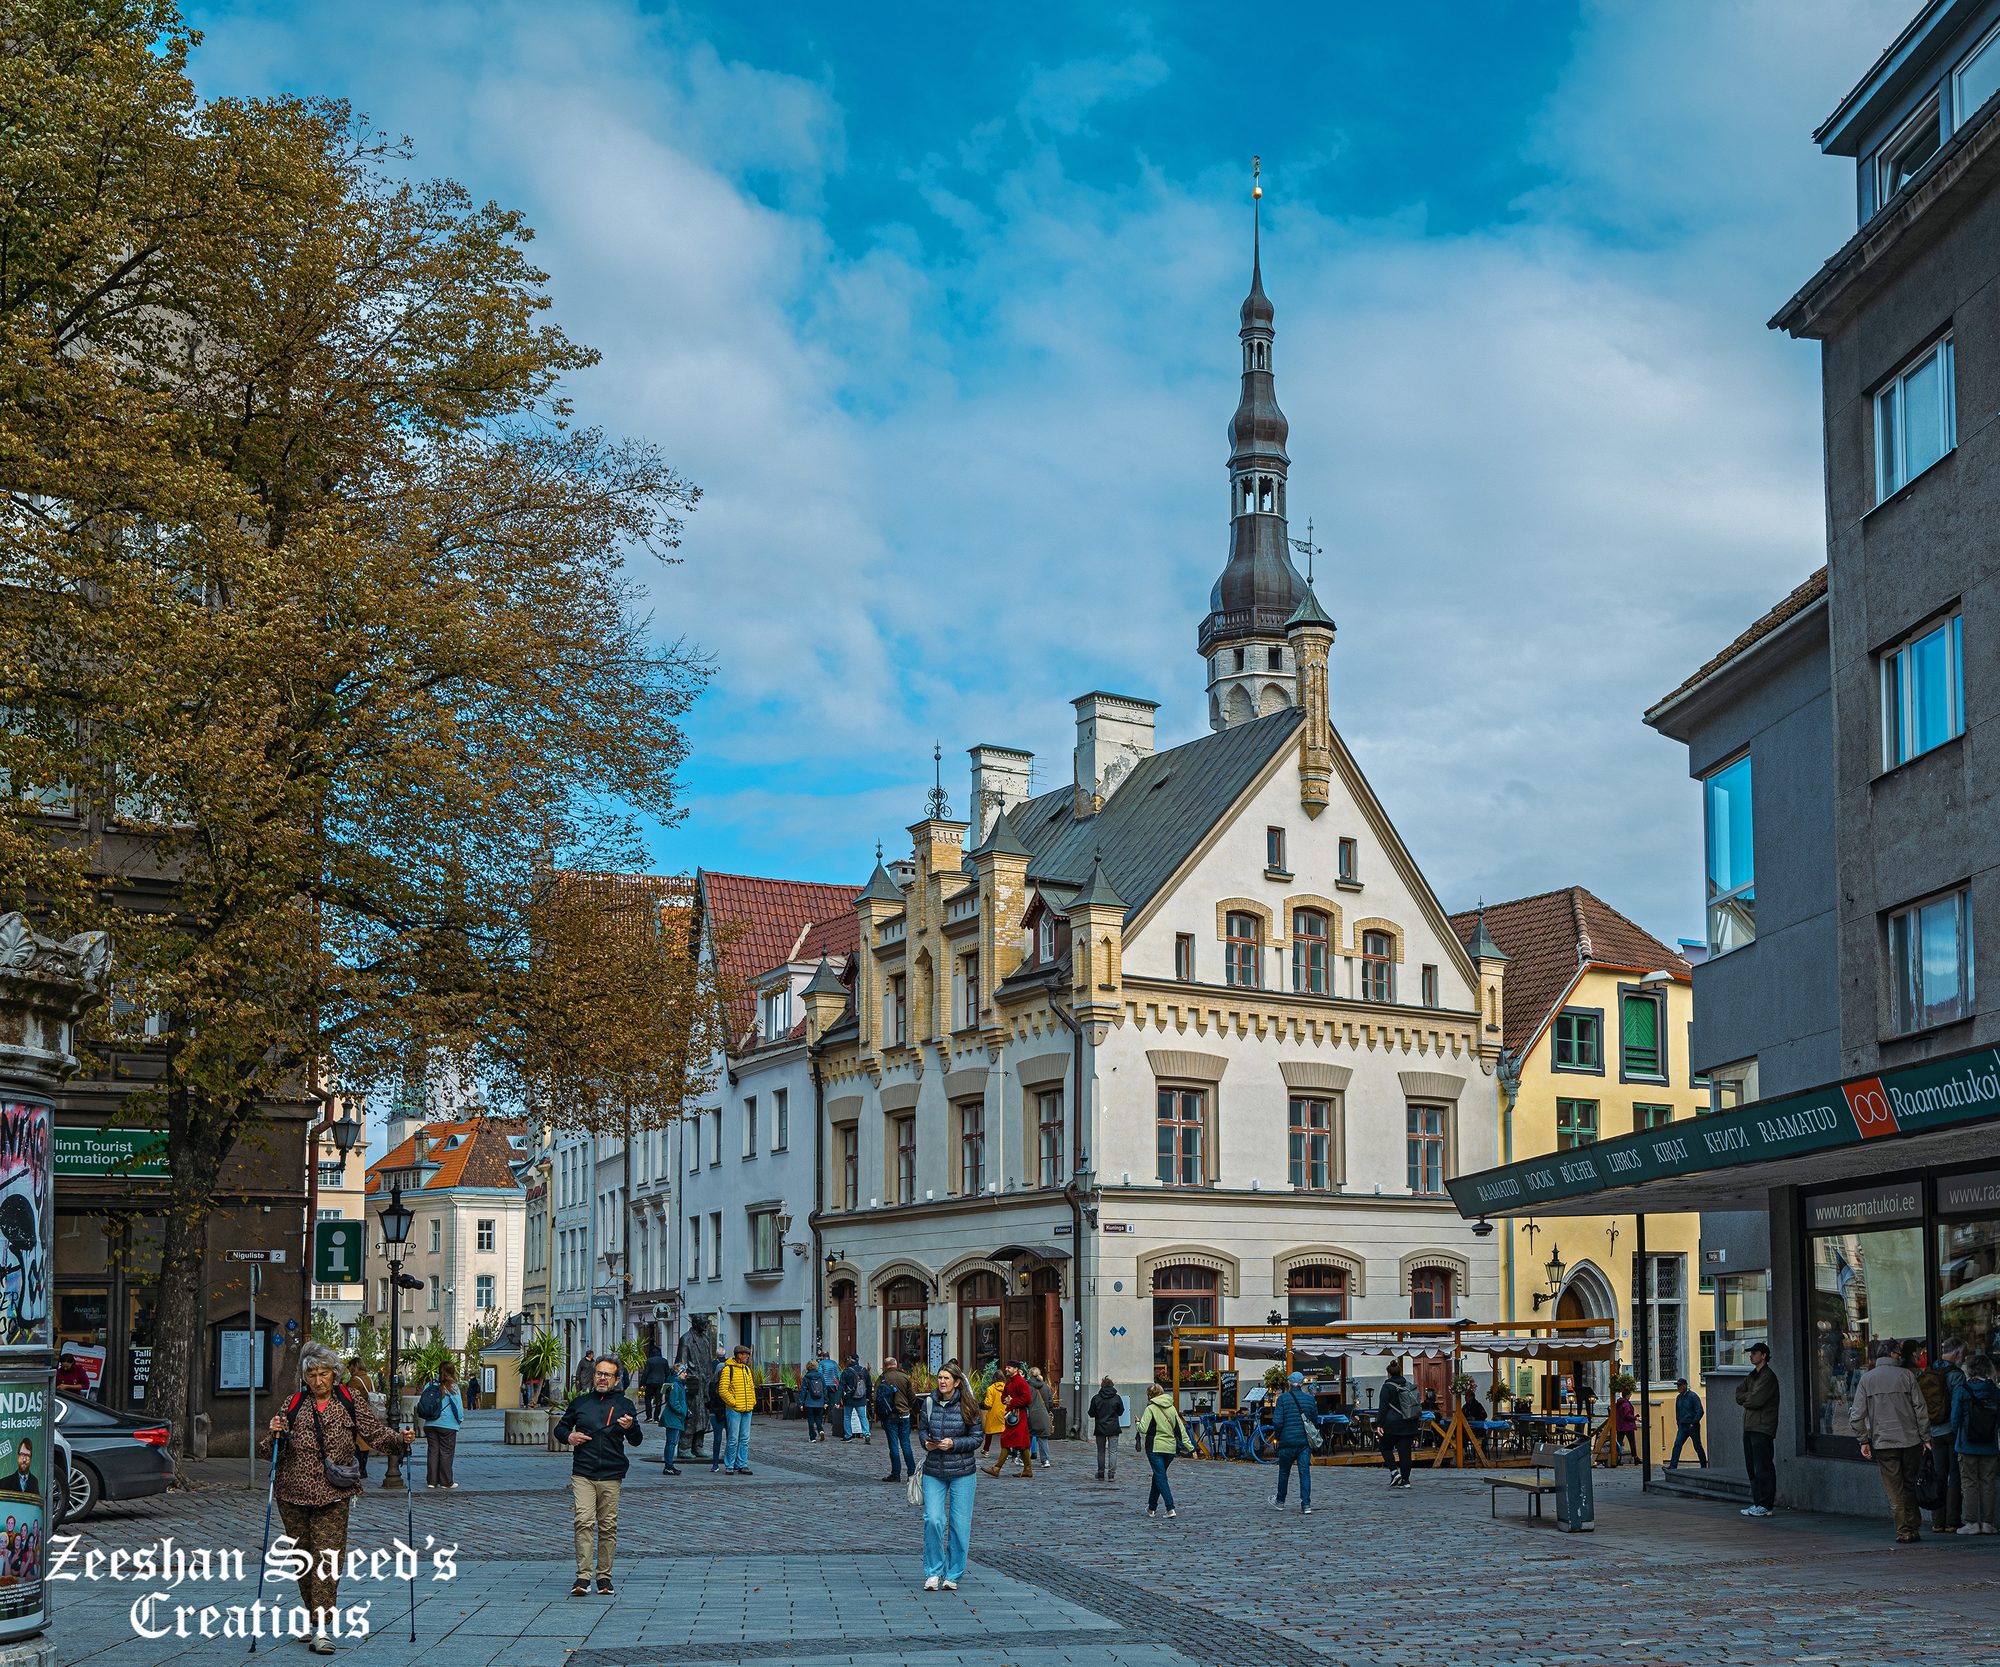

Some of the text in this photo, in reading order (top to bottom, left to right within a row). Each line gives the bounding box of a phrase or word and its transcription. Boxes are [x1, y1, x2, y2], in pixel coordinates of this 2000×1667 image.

[1890, 1064, 2000, 1118] Raamatukoi
[84, 1140, 133, 1152] Tourist
[53, 1152, 119, 1165] ormation
[1476, 1105, 1838, 1202] RAAMATUD BOOKS BÜCHER LIBROS KIRJAT КНИГИ RAAMATUD
[1815, 1193, 1915, 1221] www.raamatukoi.ee
[233, 1251, 265, 1260] Niguliste
[133, 1372, 150, 1382] city
[0, 1415, 43, 1430] sikasööjad
